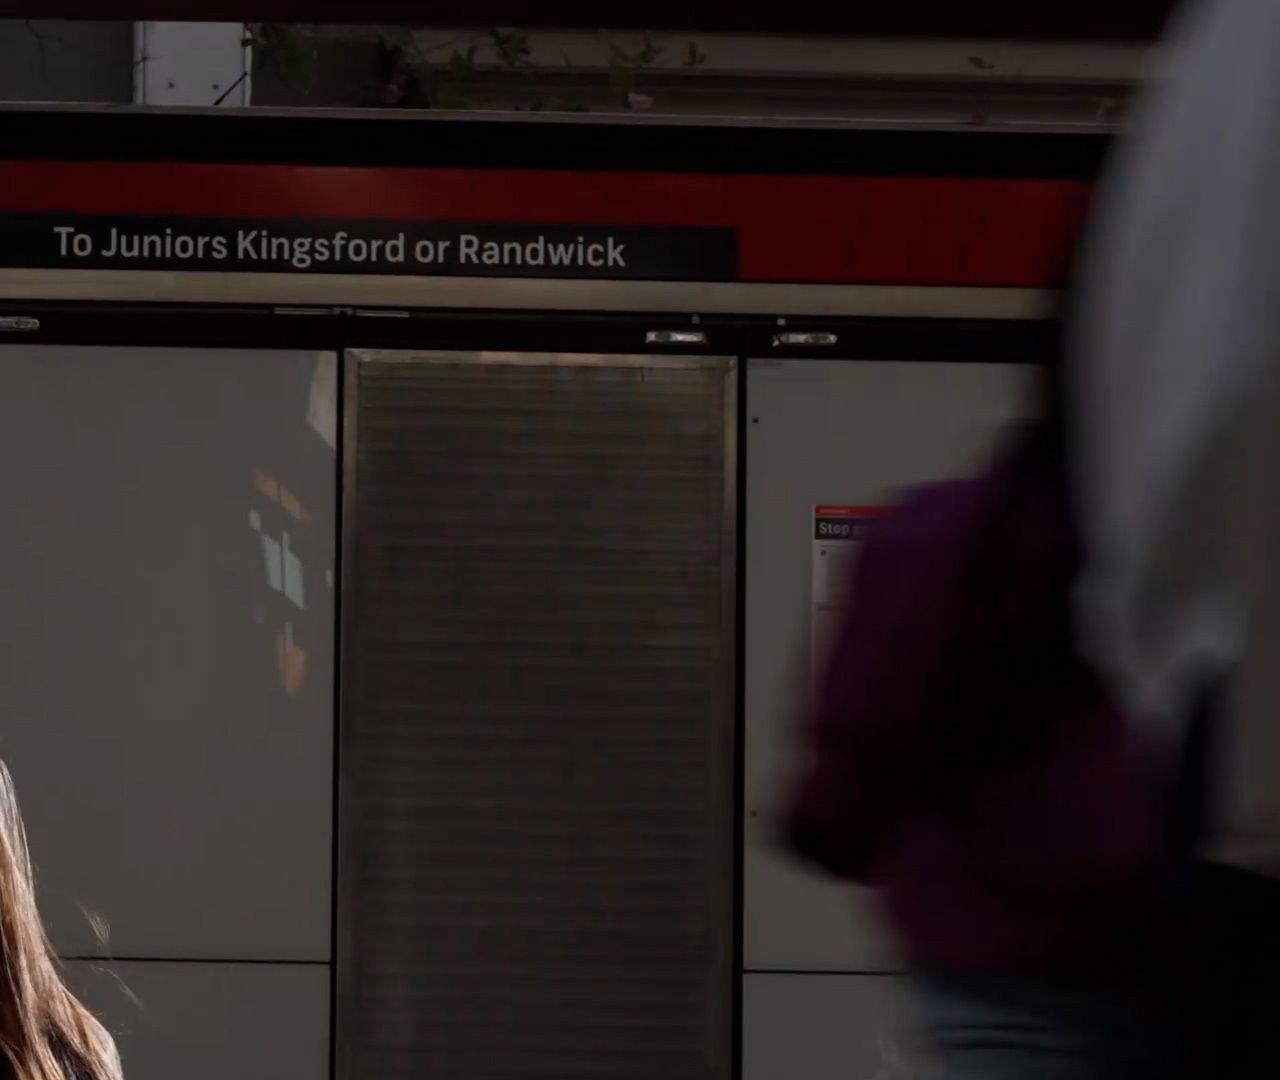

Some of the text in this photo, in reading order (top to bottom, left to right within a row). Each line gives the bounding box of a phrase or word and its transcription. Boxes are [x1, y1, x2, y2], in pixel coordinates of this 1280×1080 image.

[54, 226, 626, 267] To Juniors Kingsford or Randwick
[819, 522, 850, 537] Stop
